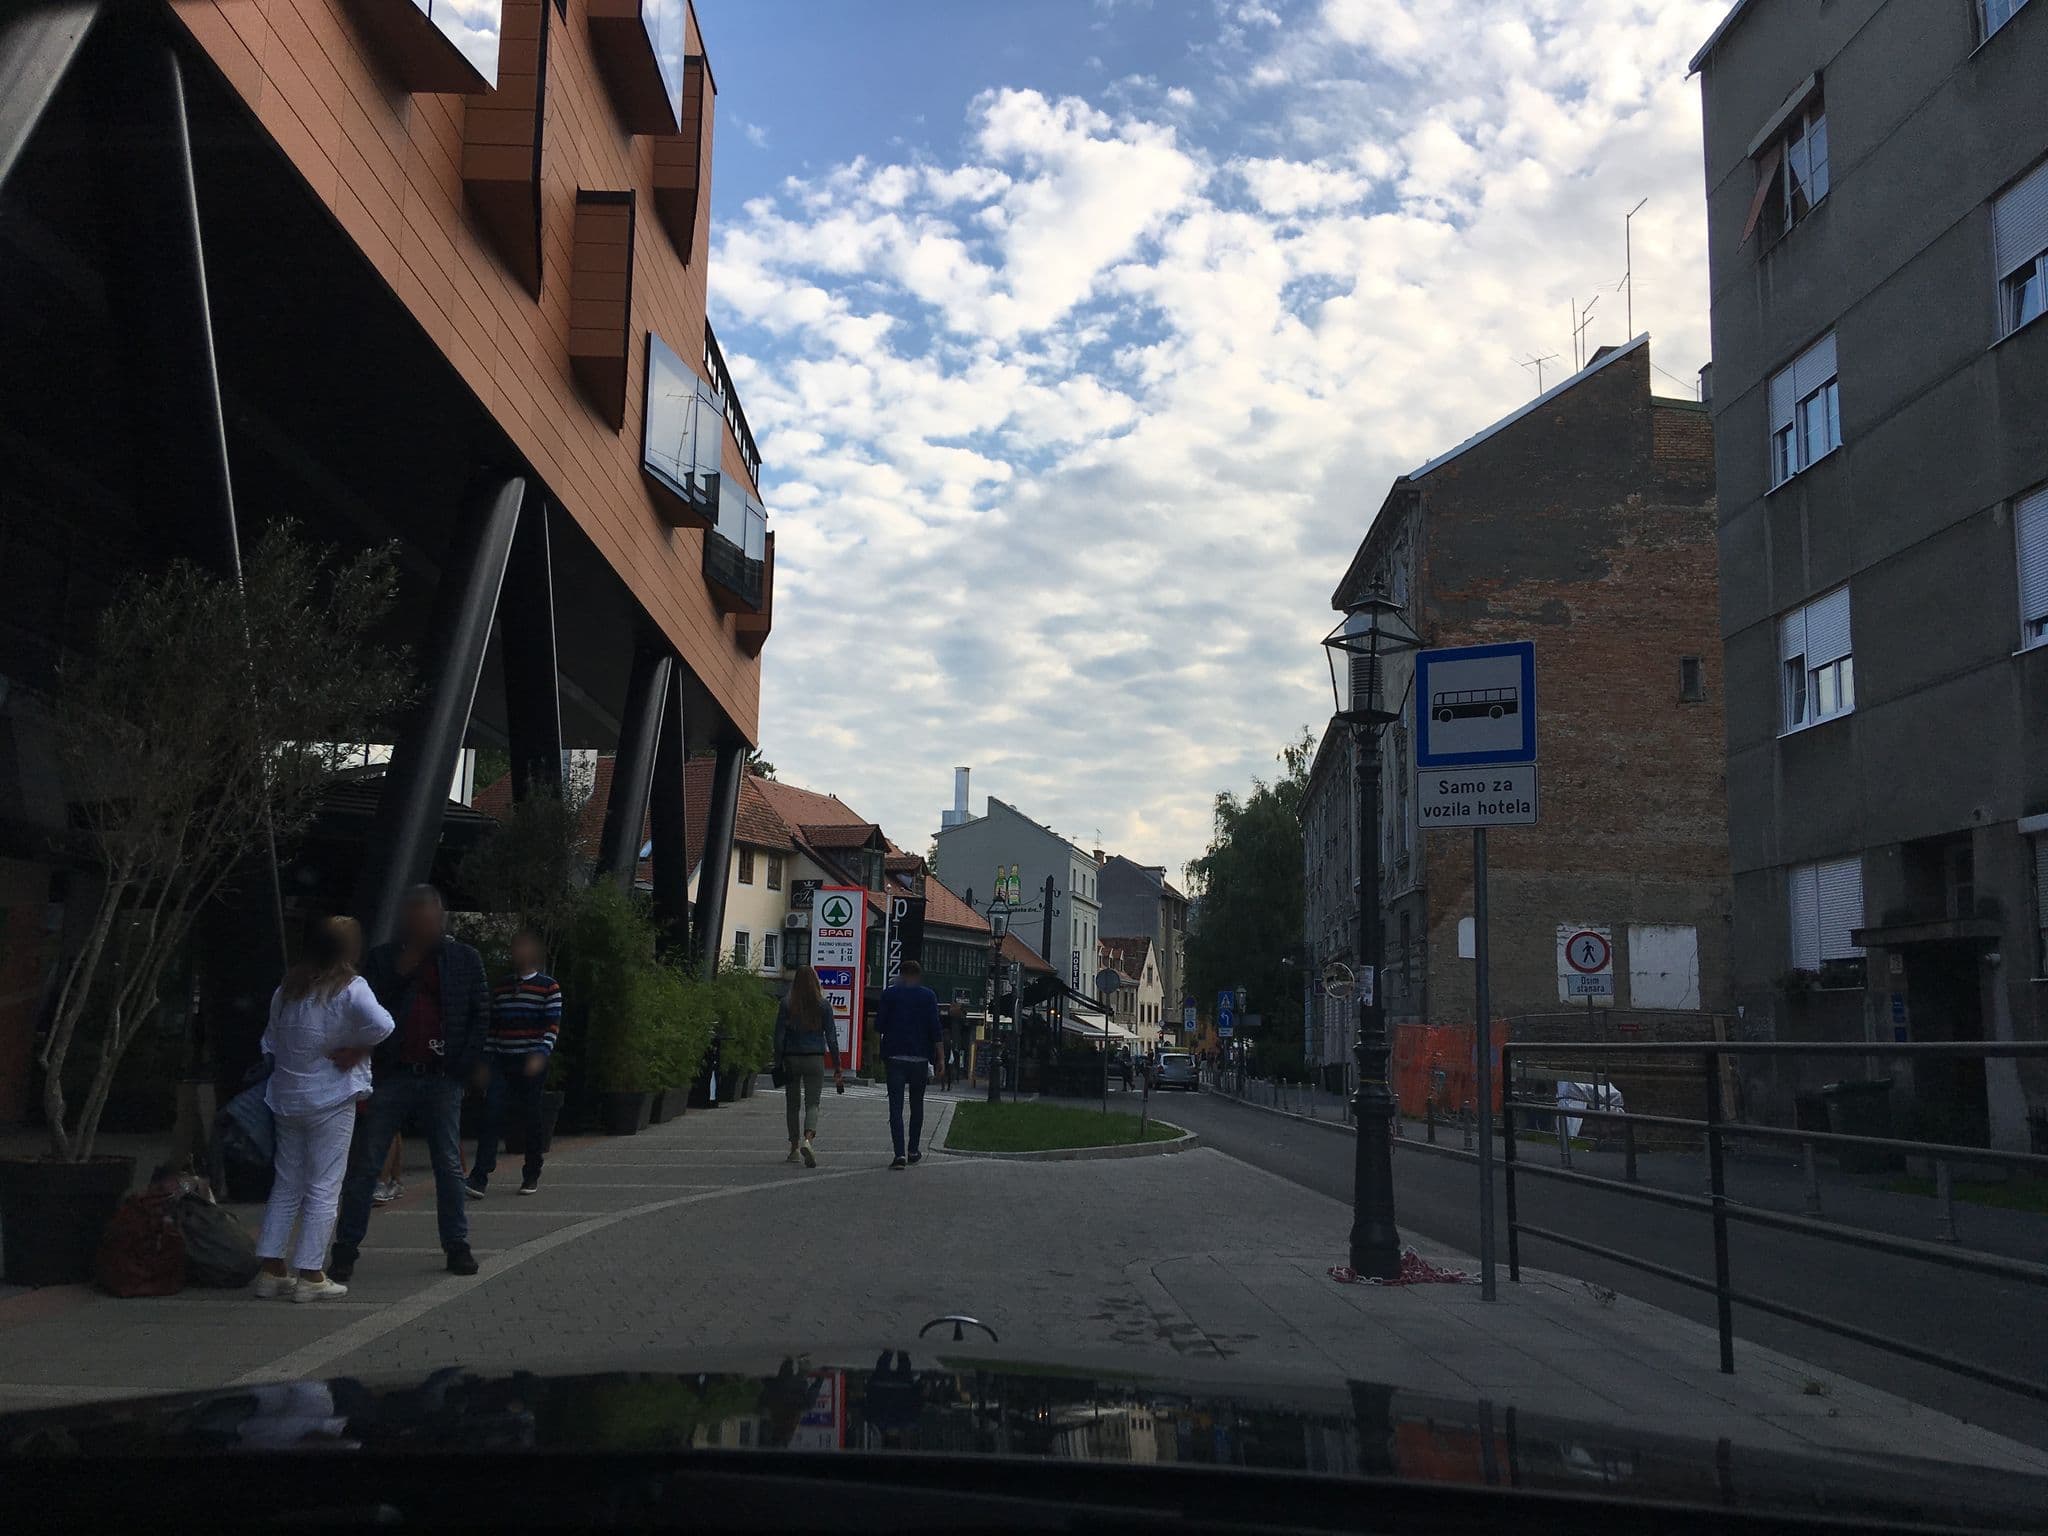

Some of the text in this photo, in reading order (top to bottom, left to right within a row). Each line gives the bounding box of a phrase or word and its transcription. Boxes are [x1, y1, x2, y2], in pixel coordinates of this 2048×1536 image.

[1439, 780, 1513, 794] Samo za
[1423, 799, 1531, 817] vozila hotela
[820, 929, 853, 937] SPAR
[1576, 985, 1605, 993] stanara
